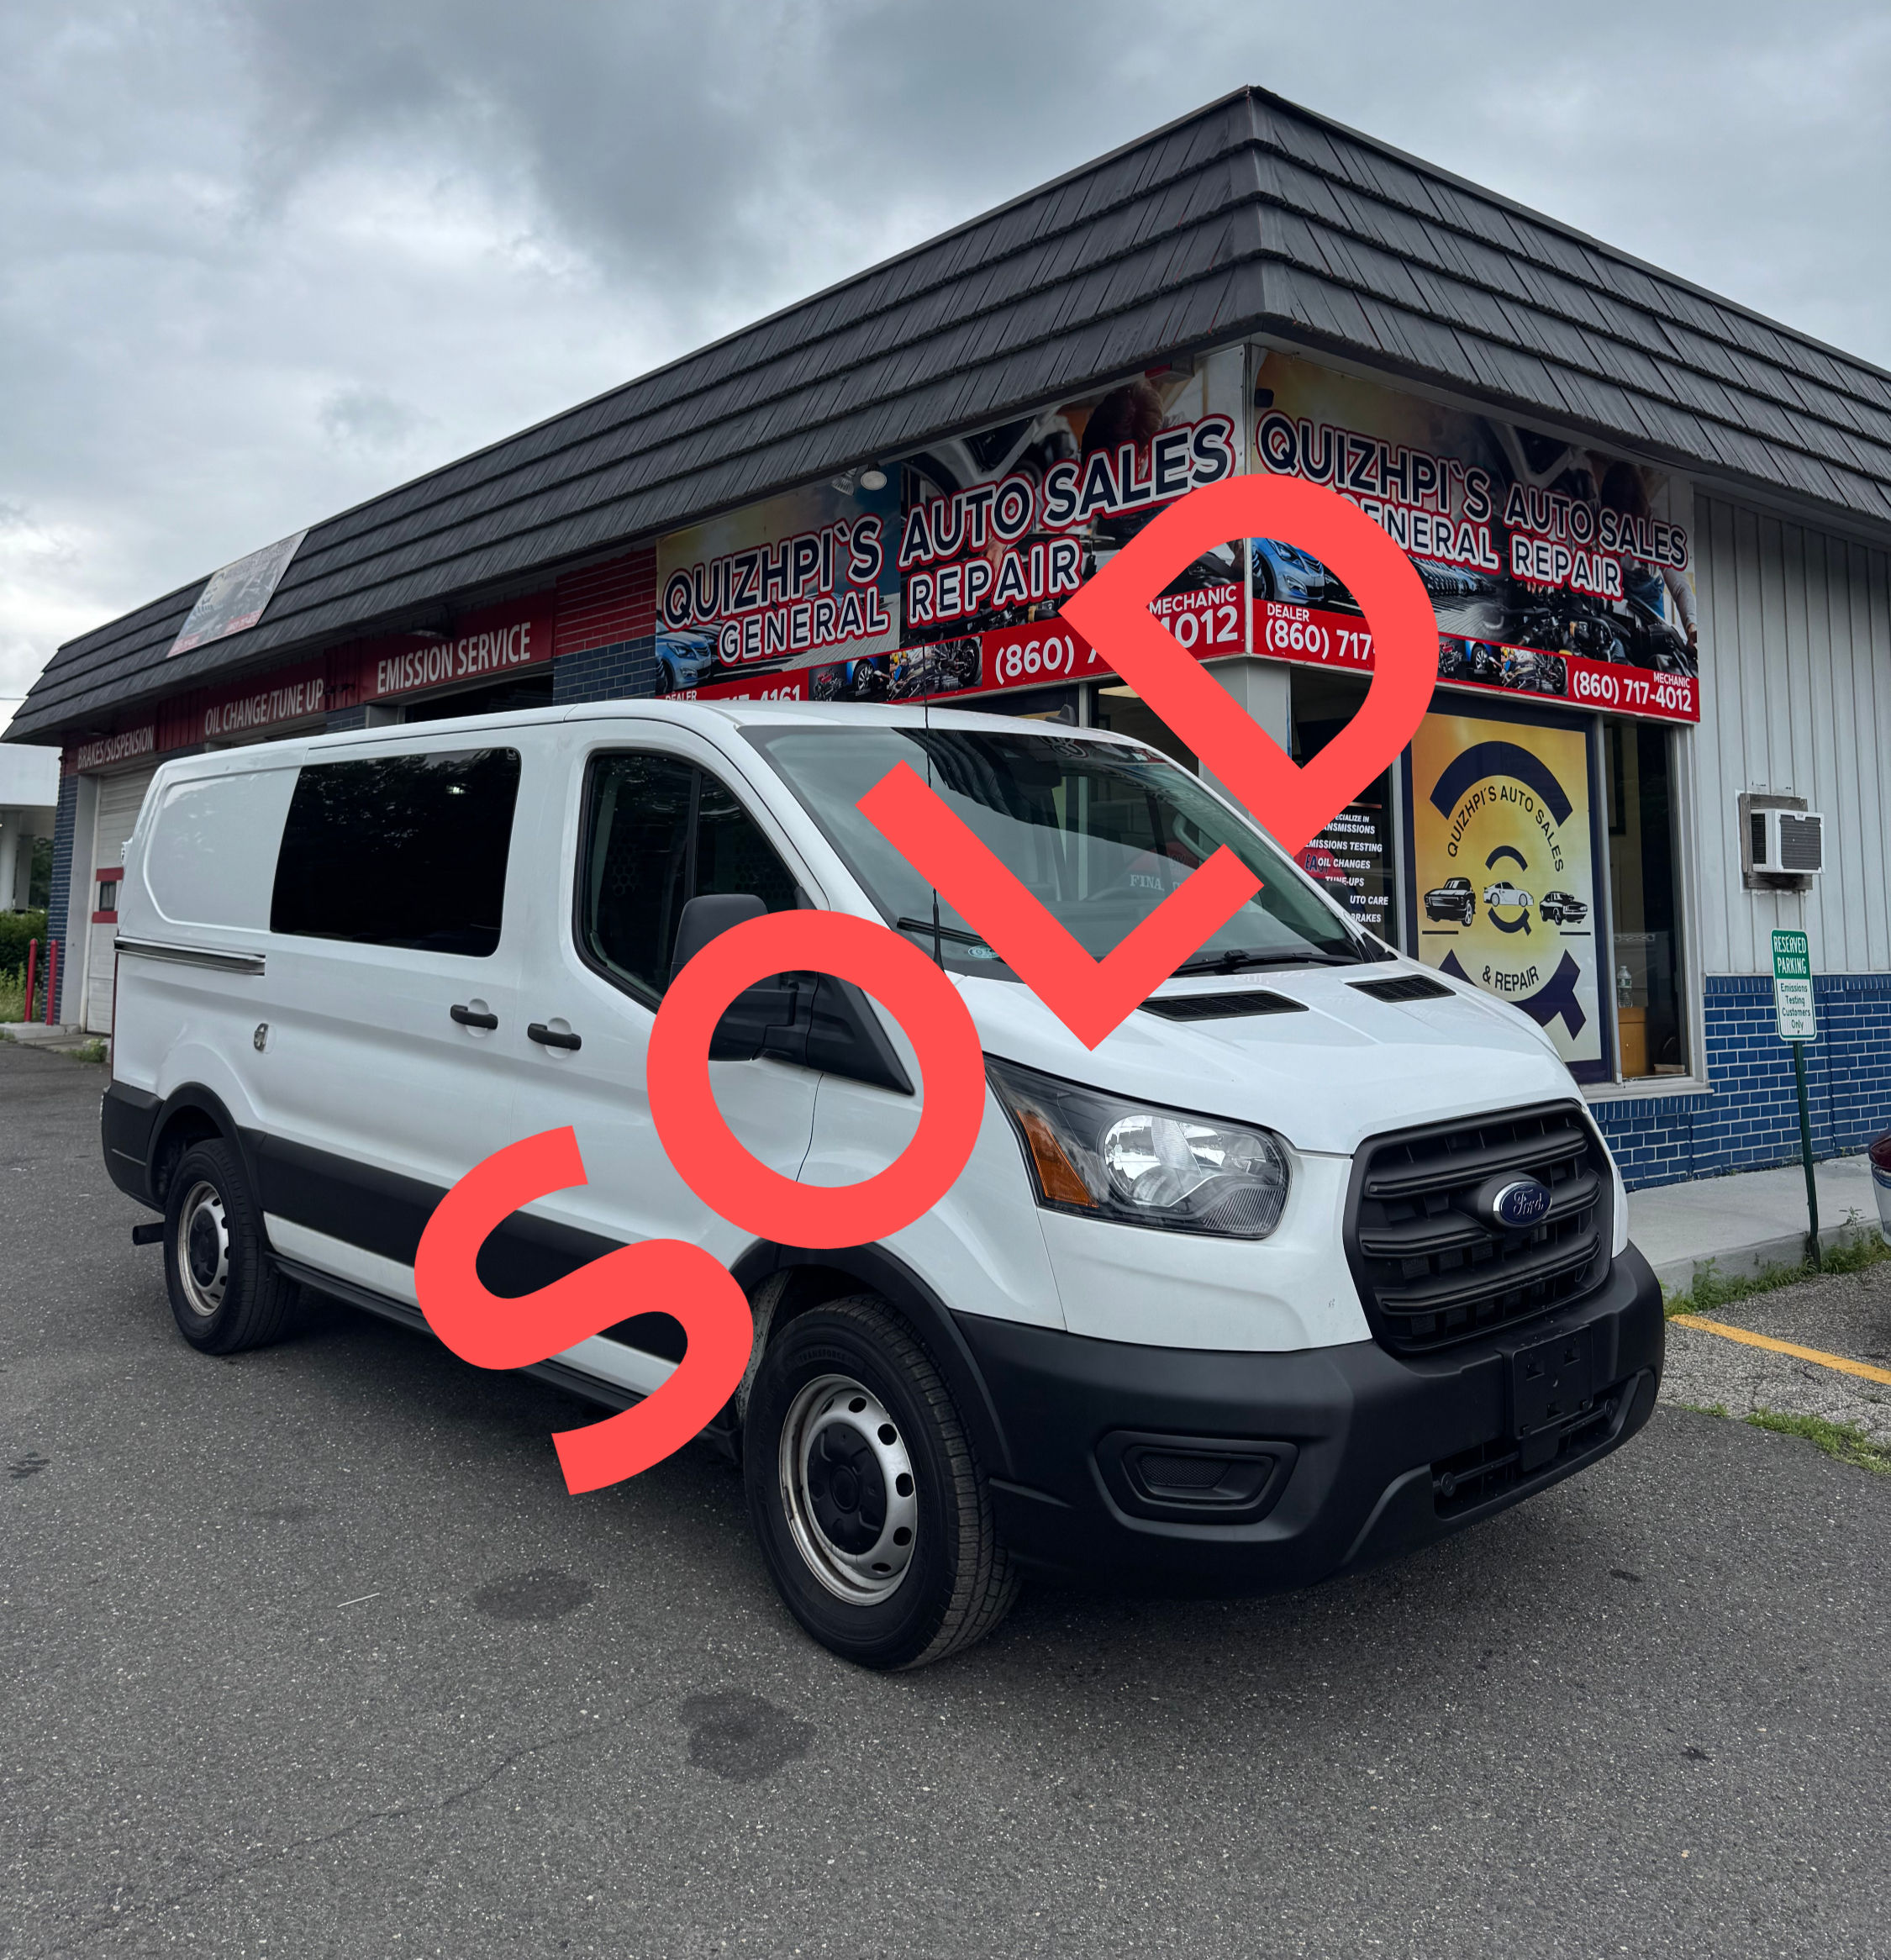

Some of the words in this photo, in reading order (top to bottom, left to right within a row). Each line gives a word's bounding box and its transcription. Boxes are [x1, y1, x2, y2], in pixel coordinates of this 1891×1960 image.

[898, 475, 1034, 568] AUTO
[1042, 418, 1233, 527] SALES
[1504, 483, 1593, 544] AUTO
[1599, 508, 1688, 569] SALES
[1340, 493, 1499, 571] NERAL
[1512, 534, 1623, 598] REPAIR
[719, 587, 889, 663] GENERAL
[908, 538, 1080, 625] REPAIR
[1149, 585, 1237, 615] MECHANIC
[1267, 603, 1310, 622] DEALER
[1266, 618, 1330, 660] (860)
[377, 642, 454, 694] EMISSION
[457, 622, 531, 676] SERVICE
[995, 635, 1075, 685] (860)
[1573, 671, 1620, 705] (860)
[1624, 678, 1693, 713] 717-4012
[1653, 672, 1690, 688] MECHANIC
[204, 709, 221, 736] OIL
[223, 684, 303, 730] CHANGE/TUNE
[306, 678, 325, 711] UP
[77, 724, 155, 771] BRAKES/SUSPENSION
[1324, 822, 1376, 835] NSMISSIONS
[1335, 814, 1362, 823] ECIALIZE
[1362, 815, 1370, 824] IN
[1500, 785, 1535, 813] AUTO
[1535, 809, 1564, 872] SALES
[1349, 841, 1383, 853] TESTING
[1318, 857, 1331, 867] OIL
[1333, 858, 1371, 869] CHANGES
[1350, 895, 1366, 904] UTO
[1368, 896, 1388, 905] CARE
[1773, 935, 1806, 954] RESERVED
[1482, 965, 1492, 985] &
[1494, 965, 1540, 992] REPAIR
[1777, 956, 1807, 975] PARKING
[1780, 983, 1808, 993] Emissions
[1785, 995, 1805, 1007] Testing
[1782, 1007, 1811, 1017] Customers
[1791, 1020, 1804, 1030] Only
[1513, 1188, 1544, 1216] Ford
